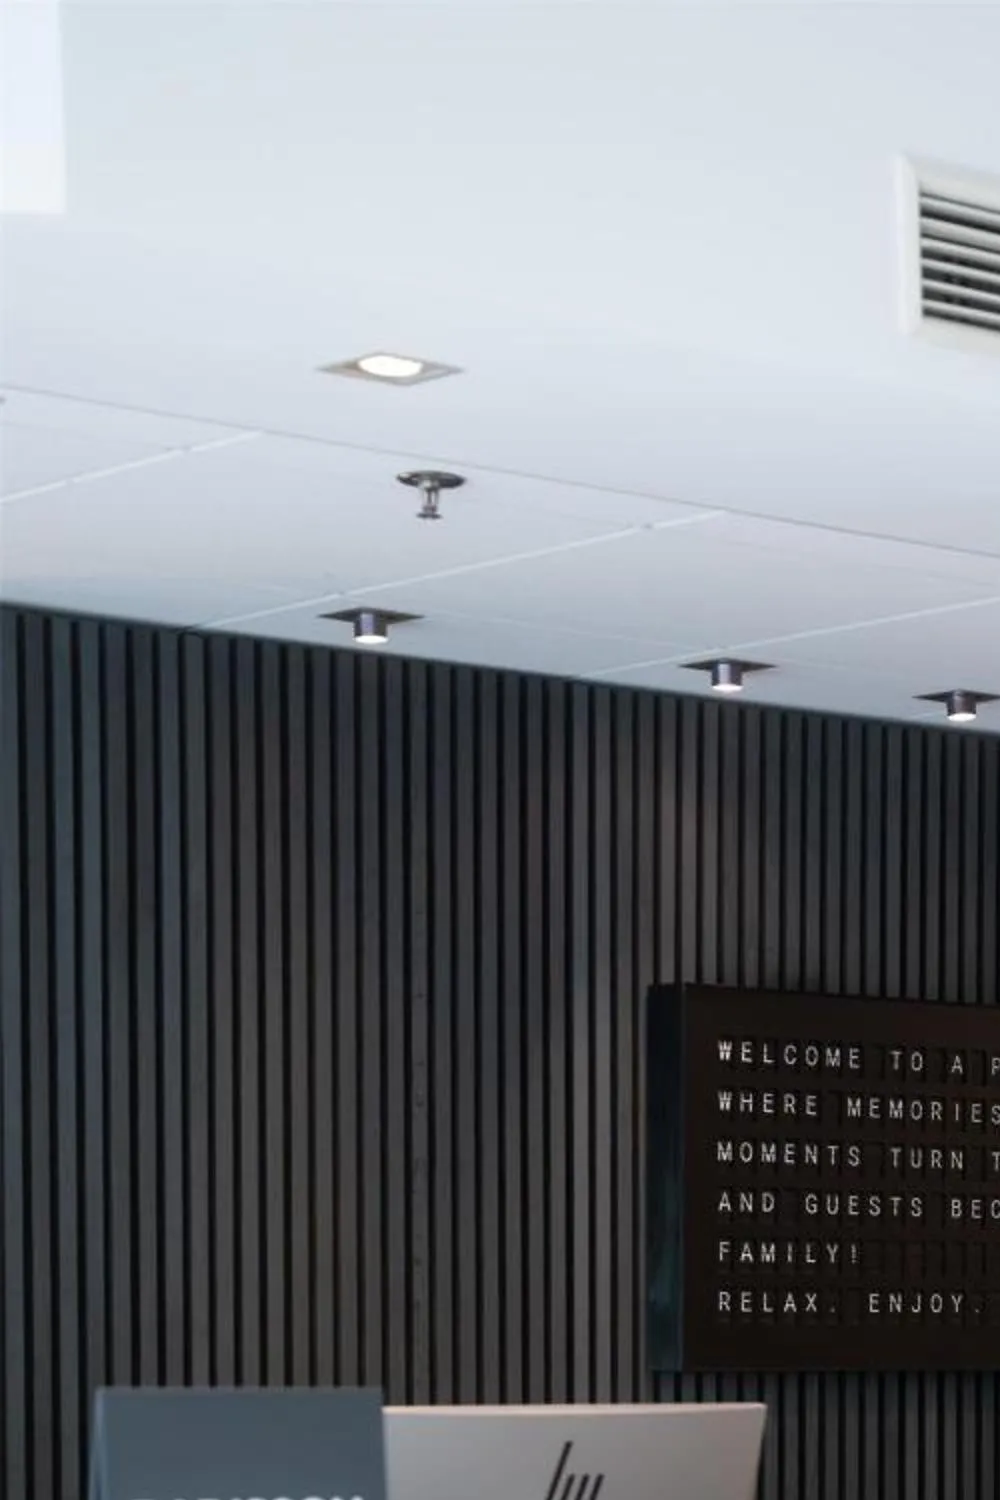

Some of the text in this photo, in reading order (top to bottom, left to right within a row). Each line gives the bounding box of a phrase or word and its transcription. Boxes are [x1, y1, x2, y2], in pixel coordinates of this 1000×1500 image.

[717, 1041, 862, 1070] WELCOME
[890, 1051, 925, 1073] TO
[951, 1055, 964, 1075] A
[718, 1091, 818, 1117] WHERE
[717, 1143, 862, 1168] MOMENTS
[890, 1147, 964, 1170] TURN
[718, 1192, 776, 1214] AND
[804, 1194, 923, 1218] GUESTS
[719, 1242, 859, 1266] FAMILY!
[719, 1292, 837, 1315] RELAX.
[868, 1294, 981, 1316] ENJOY.
